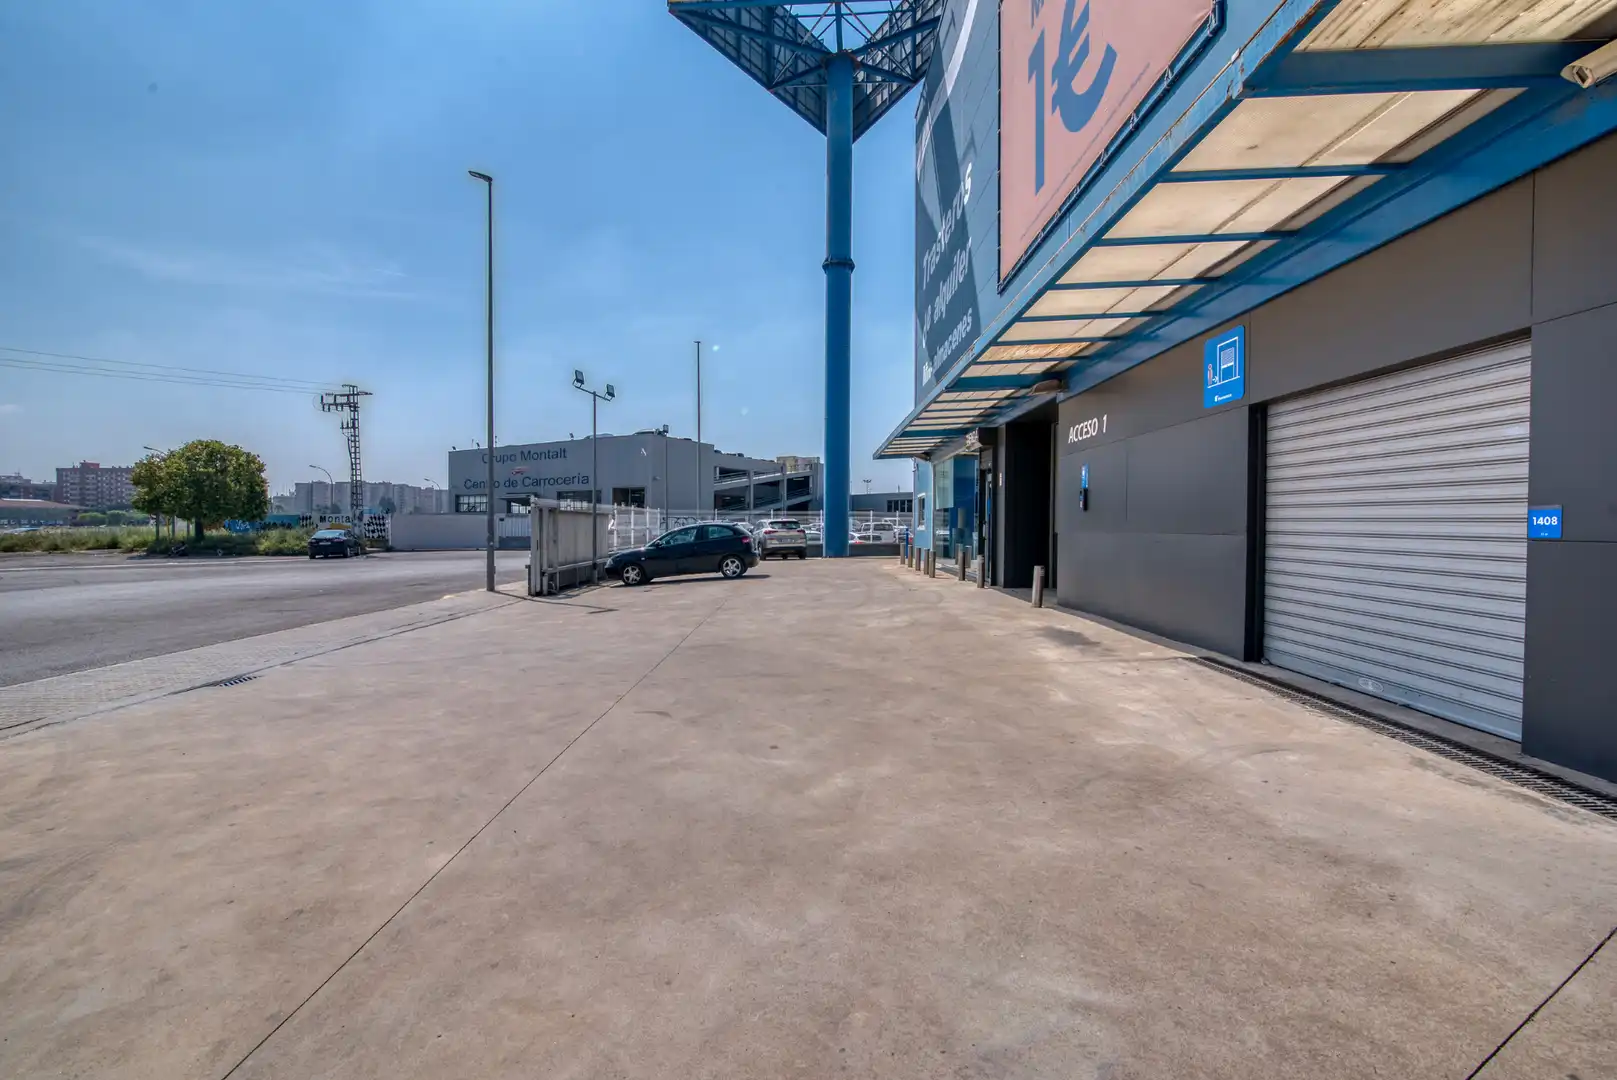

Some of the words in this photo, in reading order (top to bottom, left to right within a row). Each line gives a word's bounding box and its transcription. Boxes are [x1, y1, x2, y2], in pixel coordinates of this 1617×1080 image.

[923, 162, 972, 291] Trasteros
[933, 236, 972, 324] alquiler
[1068, 417, 1099, 444] ACCESO
[1102, 413, 1108, 434] 1
[520, 447, 567, 461] Montalt
[463, 479, 500, 490] Ceno
[503, 477, 518, 488] de
[1532, 516, 1558, 526] 1408
